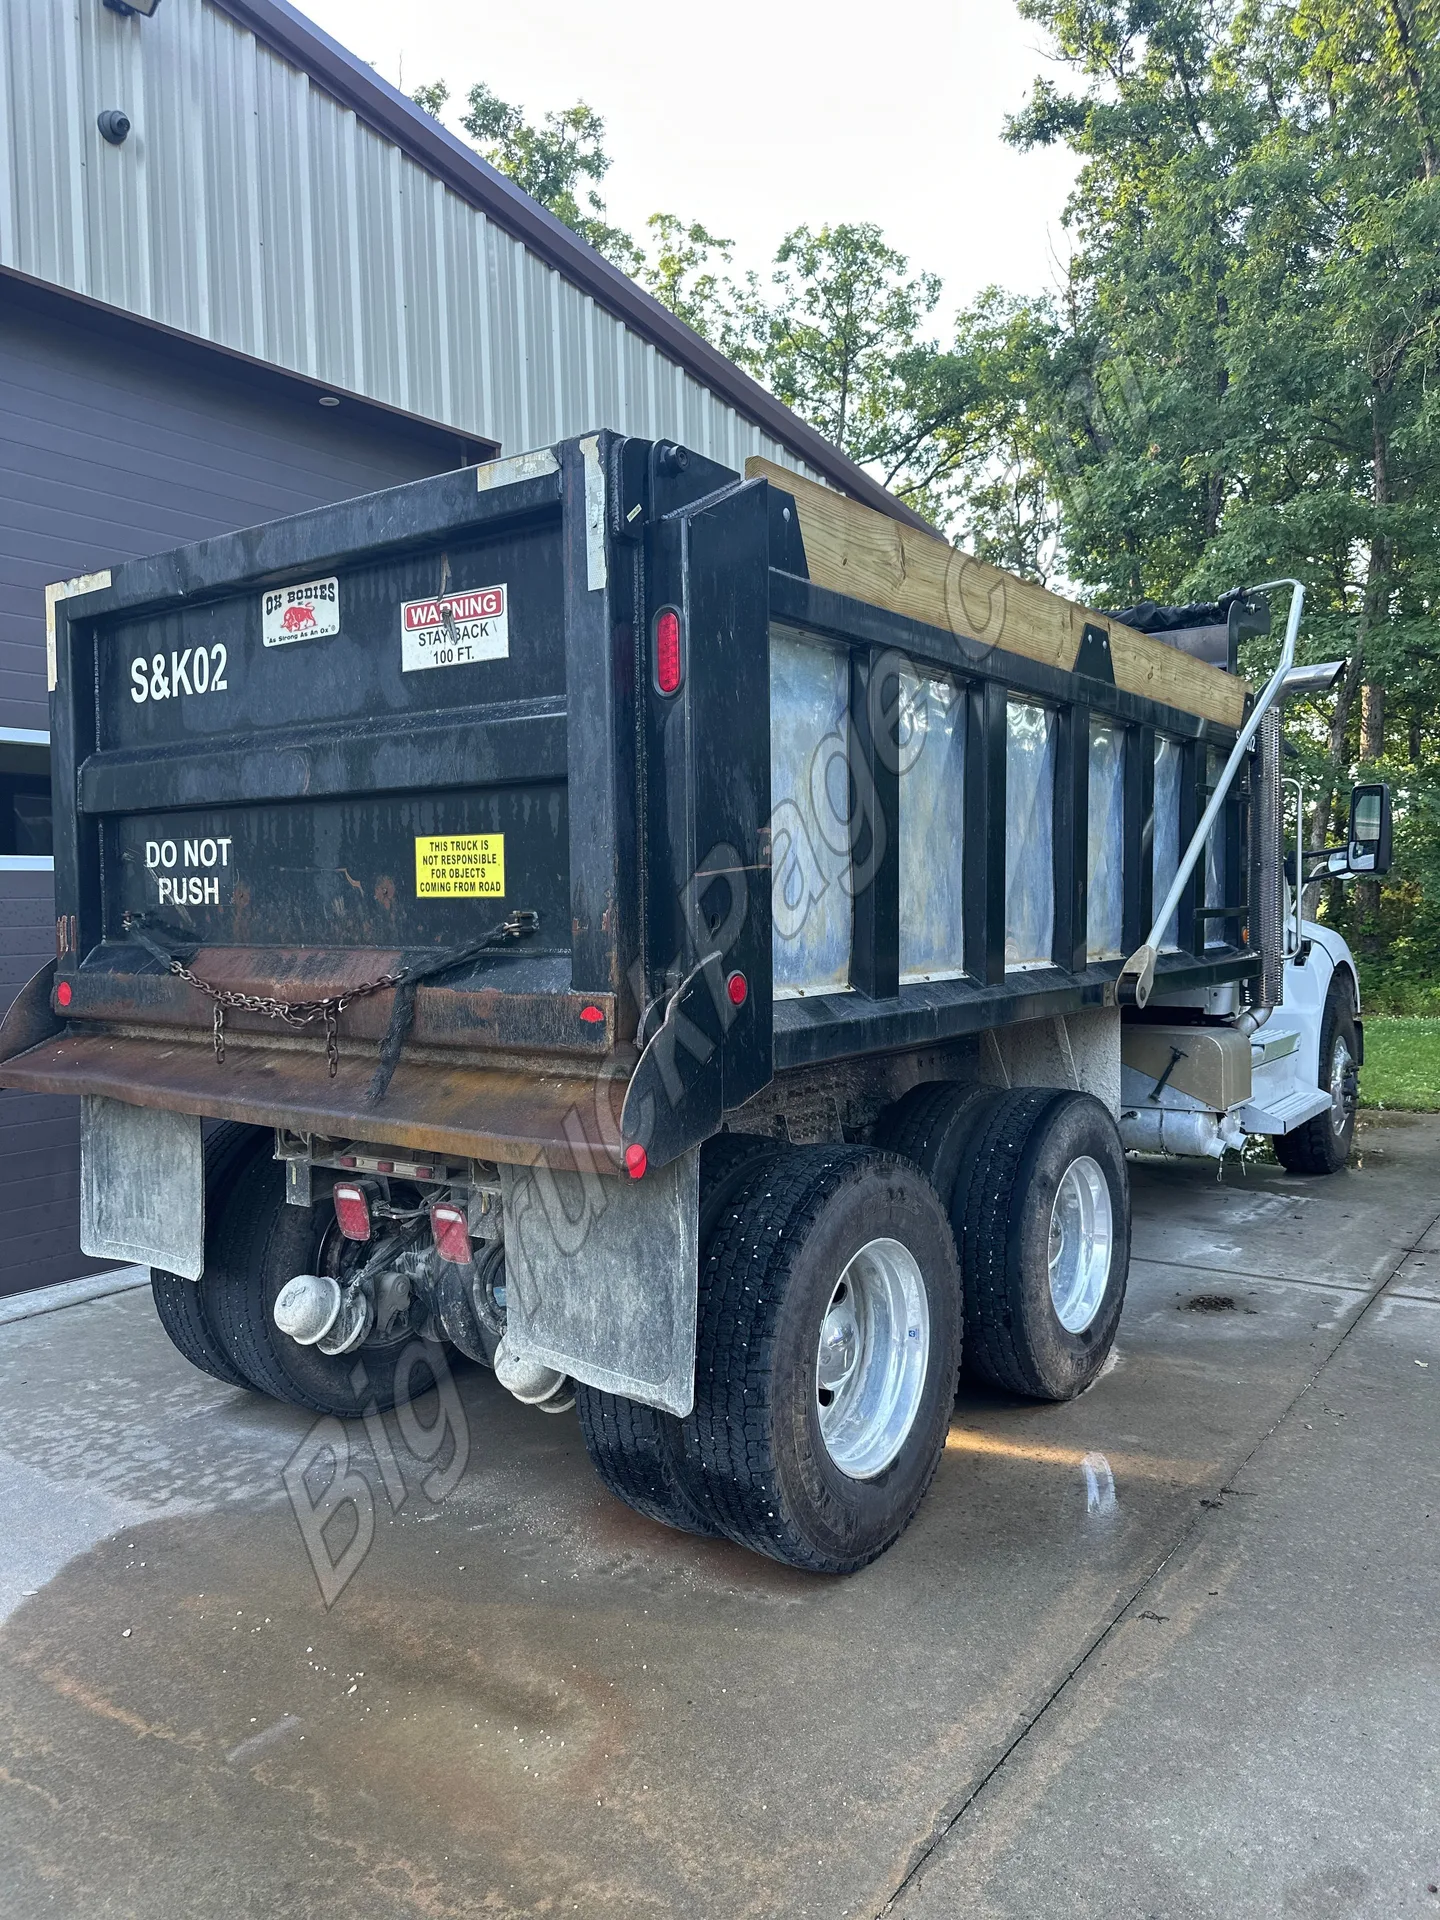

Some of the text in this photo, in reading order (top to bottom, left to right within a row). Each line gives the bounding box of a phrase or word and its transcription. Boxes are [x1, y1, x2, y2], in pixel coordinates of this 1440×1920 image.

[265, 582, 335, 615] OX BODIES
[418, 621, 489, 647] STAY BACK
[433, 646, 475, 664] 100 FT.
[131, 643, 227, 703] S&K02
[146, 838, 232, 868] DO NOT
[430, 840, 489, 852] THIS TRUCK IS
[423, 854, 497, 865] NOT RESPONSIBLE
[431, 868, 486, 879] FOR OBJECTS
[158, 877, 219, 905] PUSH
[420, 881, 501, 892] COMING FROM ROAD
